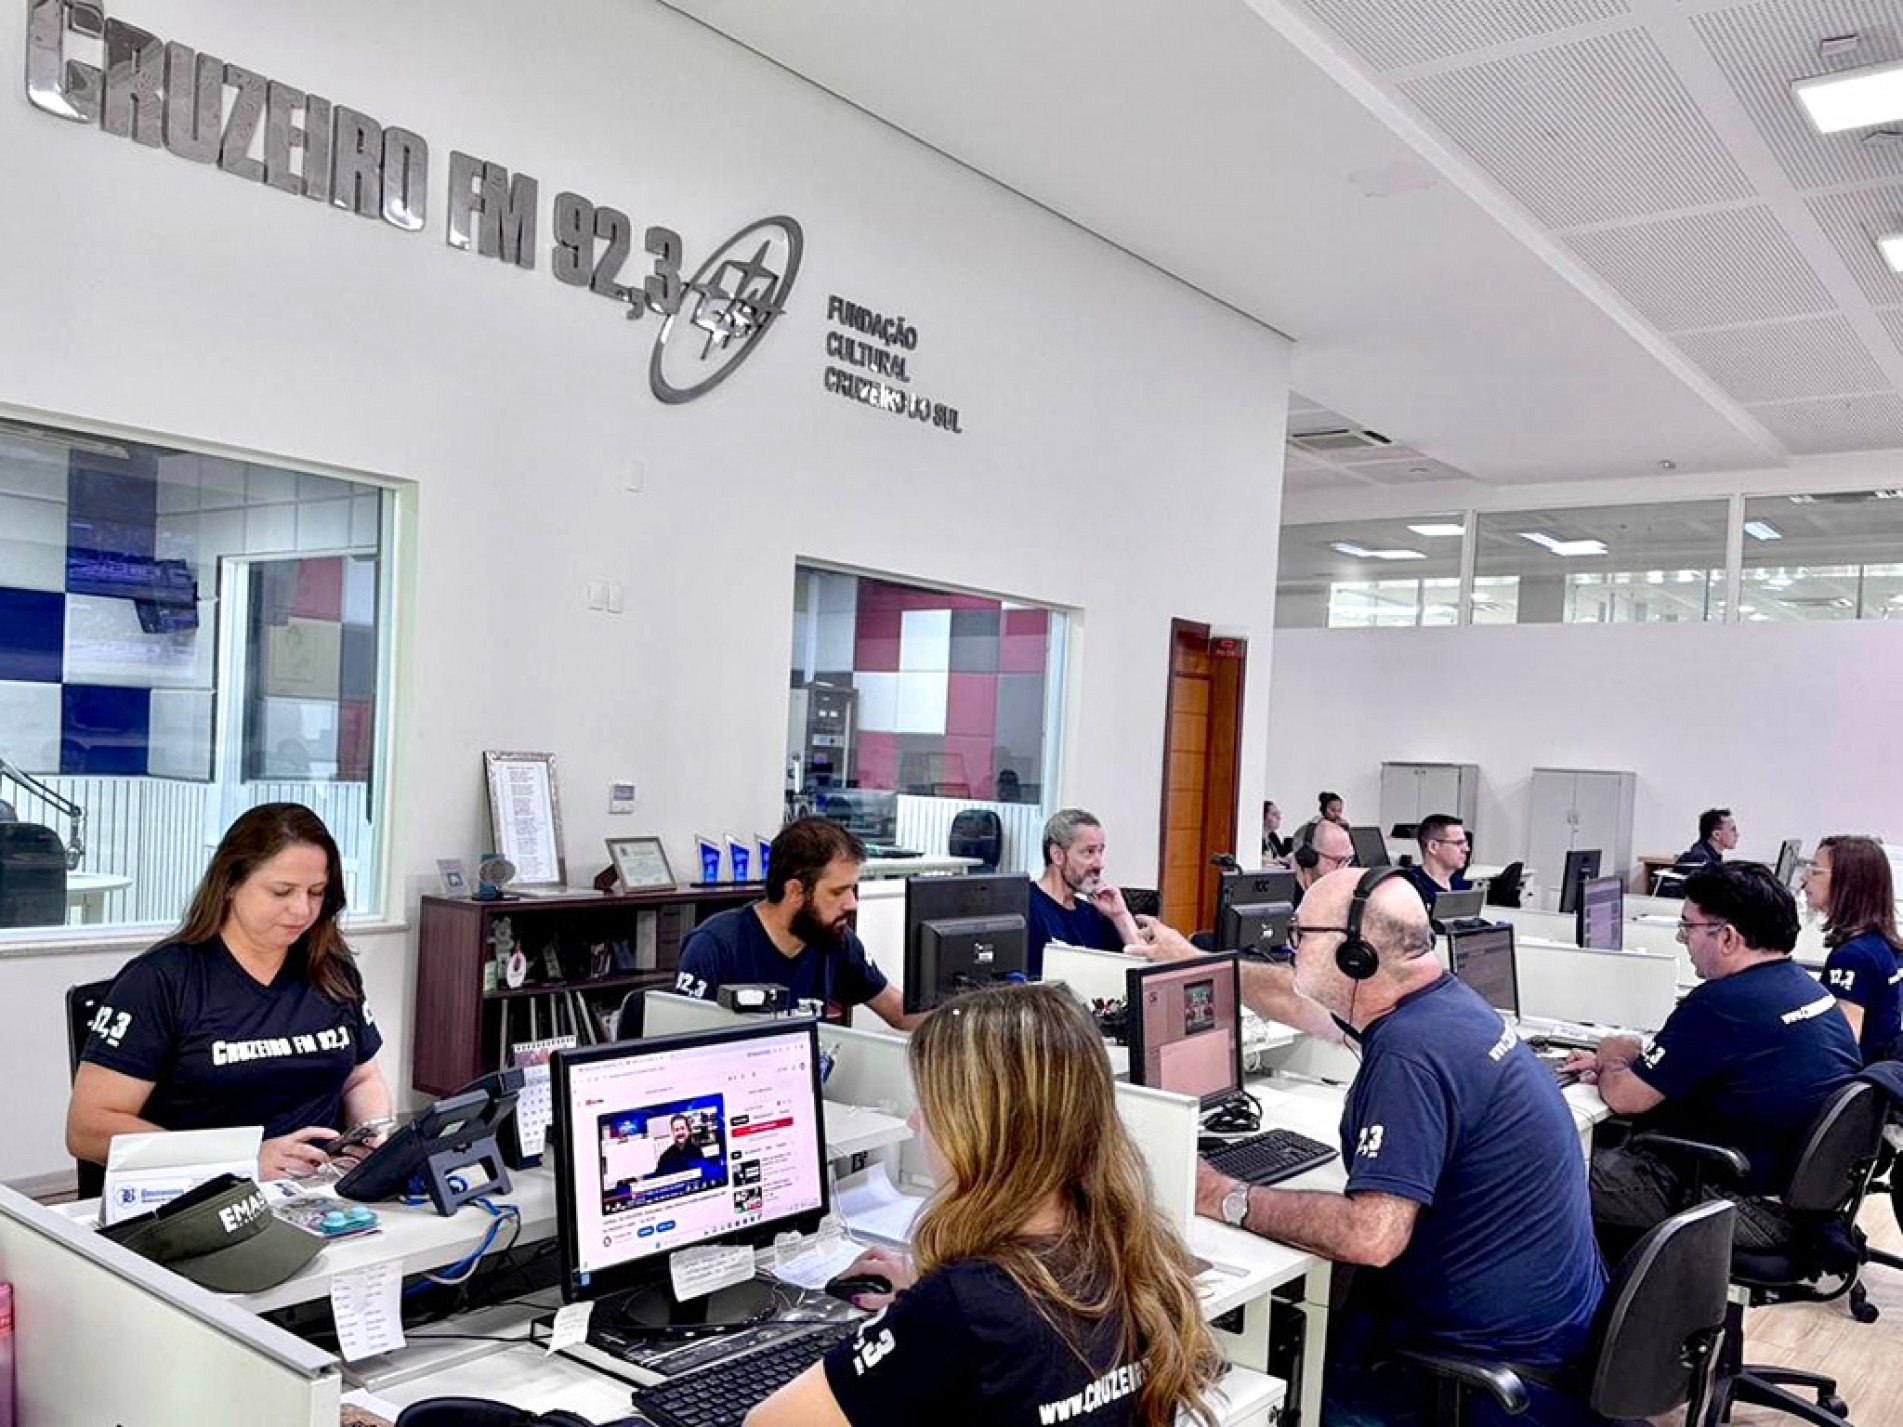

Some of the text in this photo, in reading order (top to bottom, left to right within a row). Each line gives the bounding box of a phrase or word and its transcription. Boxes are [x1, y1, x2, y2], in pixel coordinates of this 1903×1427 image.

[26, 0, 683, 321] CRUZEIRO FM 92,3
[827, 294, 918, 351] FUNDAÇÃO
[826, 330, 911, 383] CULTURAL
[932, 402, 962, 433] SUL
[211, 1037, 292, 1066] CRUZEIRO
[292, 1034, 318, 1054] FM
